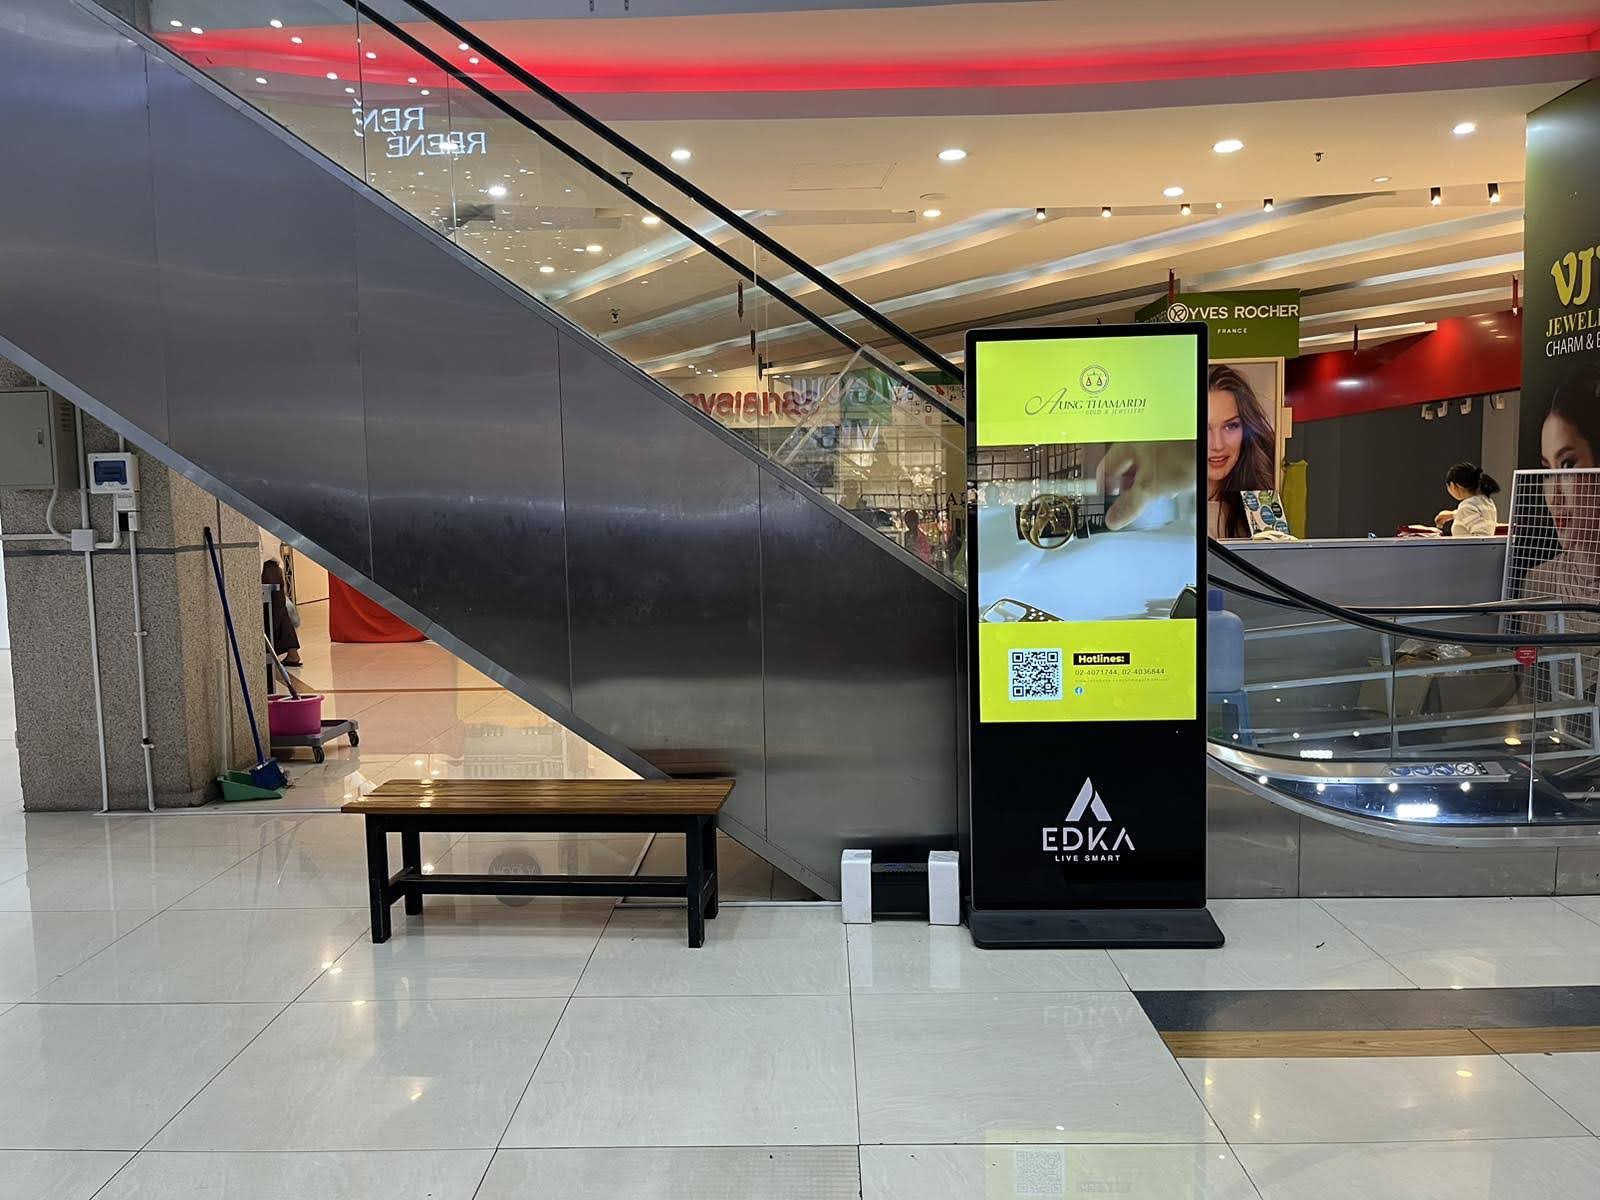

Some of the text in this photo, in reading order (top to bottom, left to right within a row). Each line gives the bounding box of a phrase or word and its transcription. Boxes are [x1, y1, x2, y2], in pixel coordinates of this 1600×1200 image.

[1189, 304, 1299, 319] YVES ROCHER
[1546, 308, 1600, 337] JEWEL
[1546, 335, 1583, 357] CHARM
[1586, 333, 1594, 350] &
[1087, 398, 1147, 409] THAMARDI
[1078, 654, 1125, 663] Hotlines:
[1042, 827, 1135, 851] EDKA
